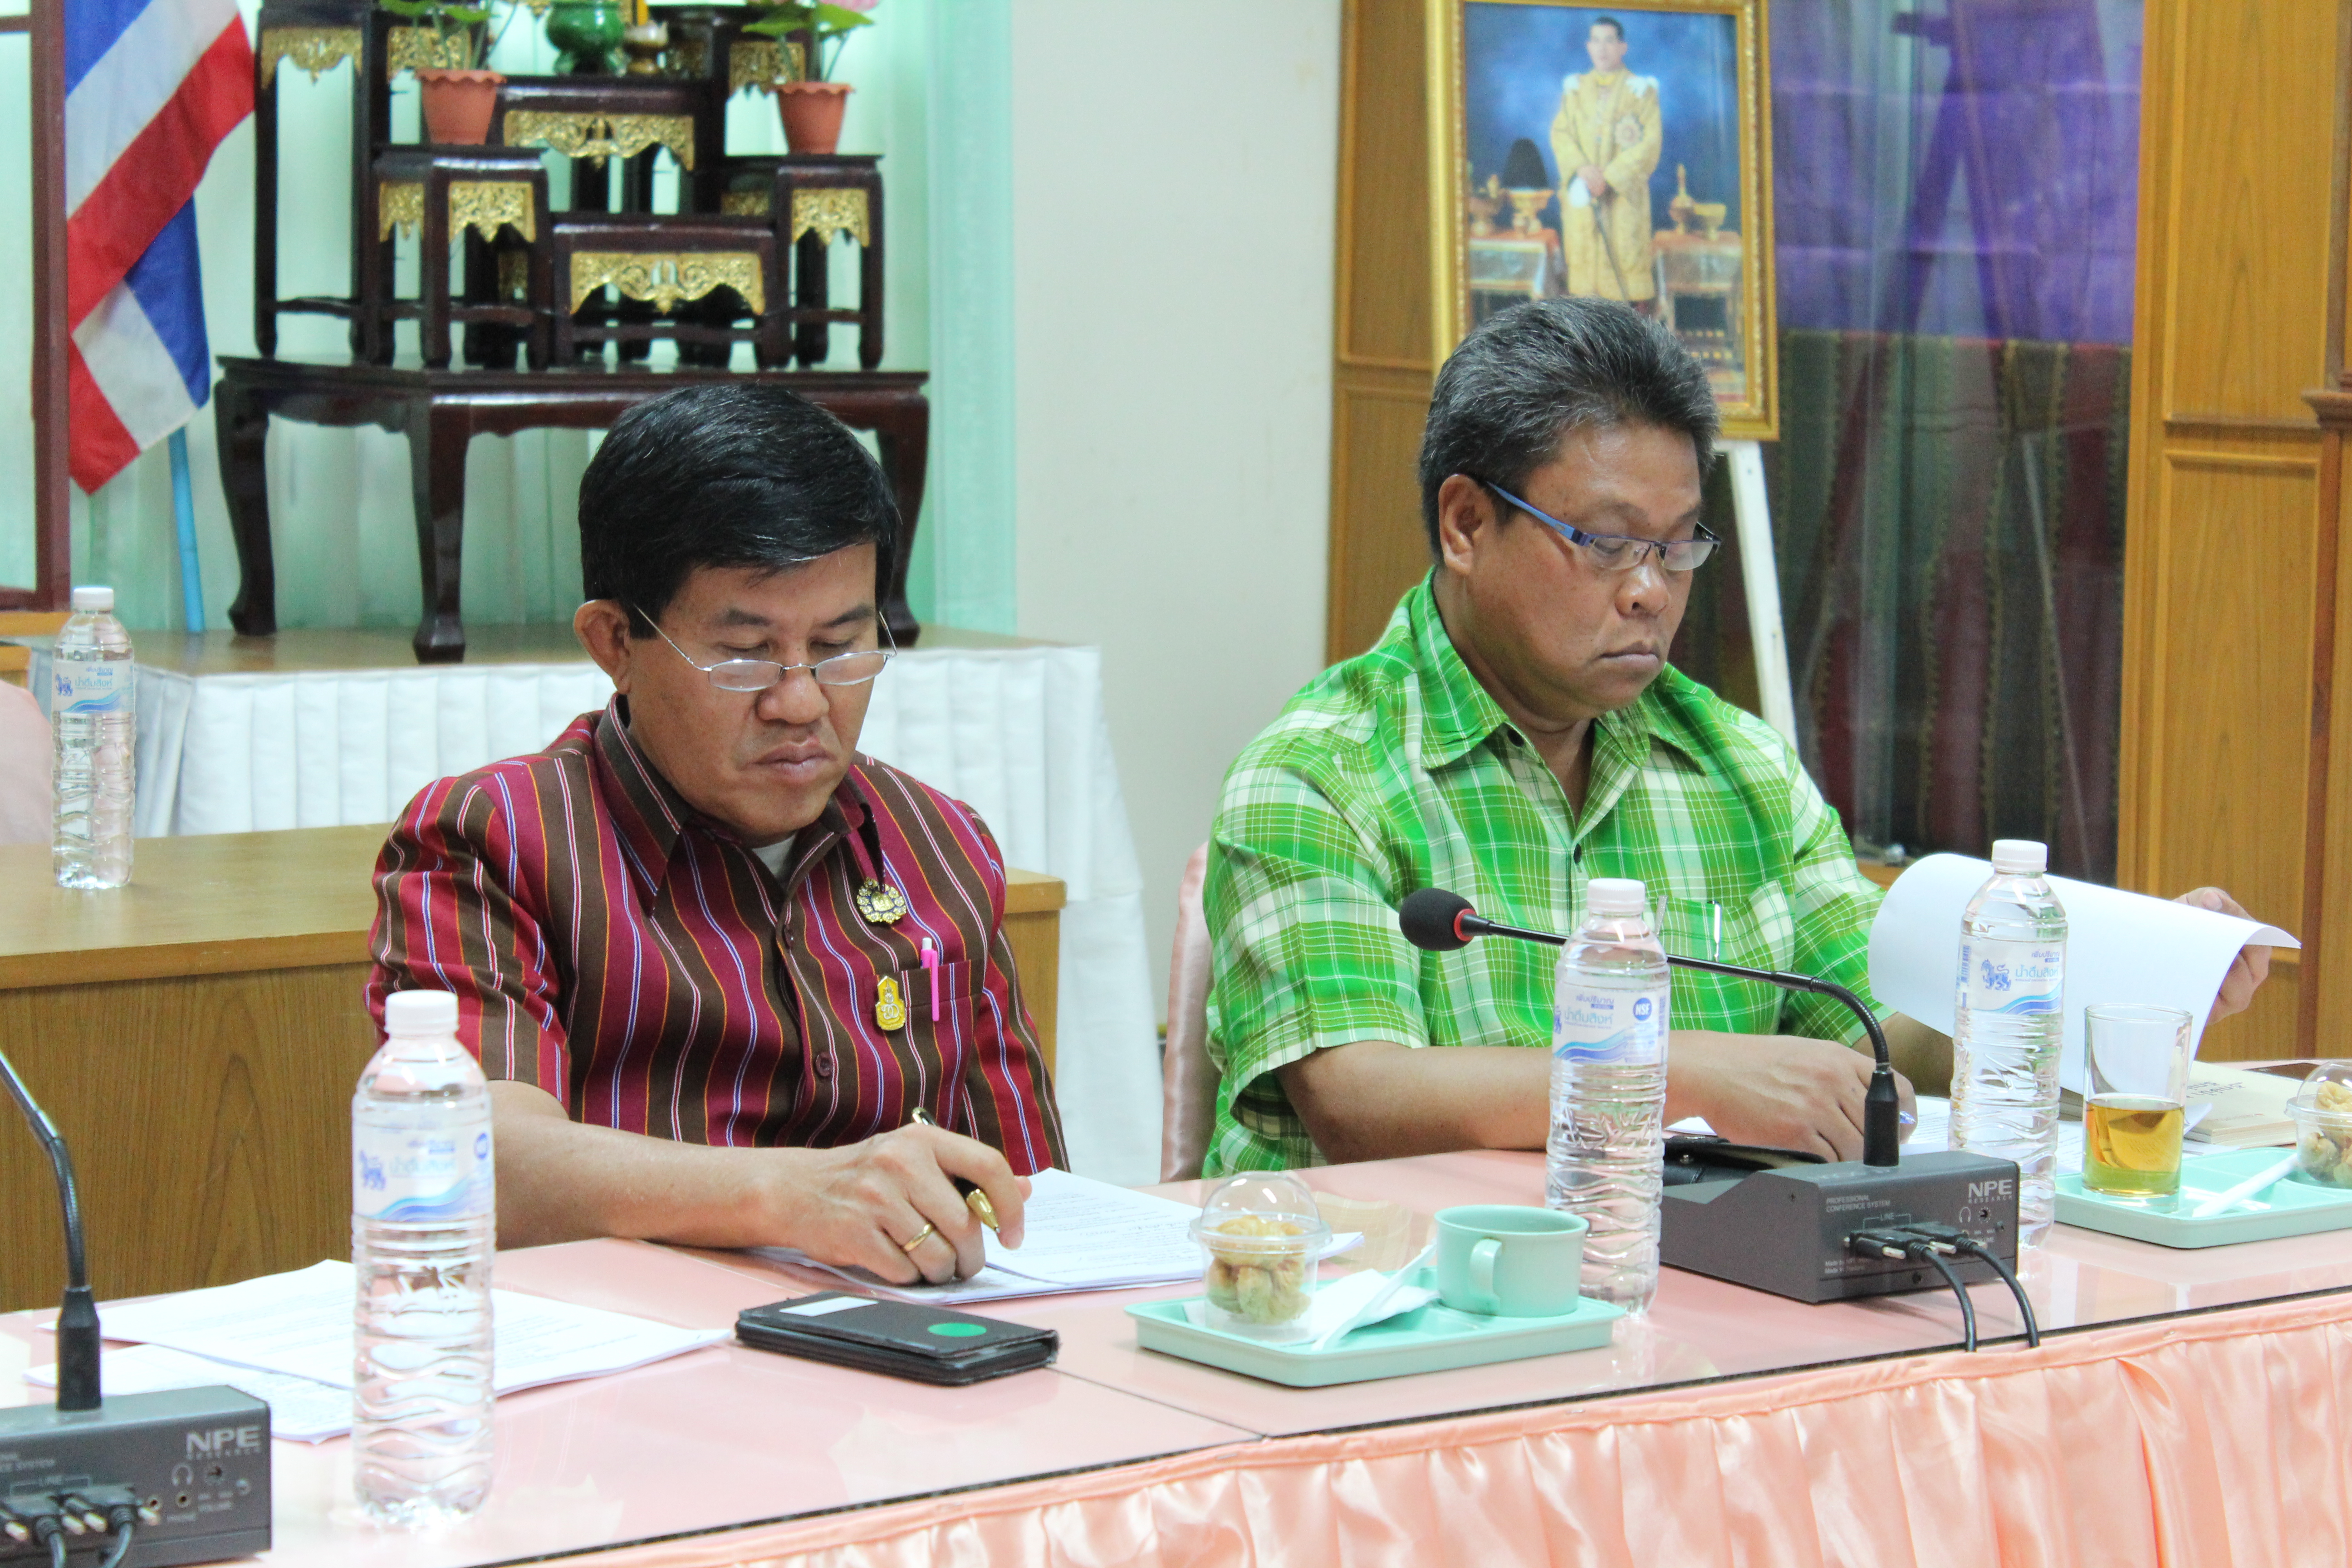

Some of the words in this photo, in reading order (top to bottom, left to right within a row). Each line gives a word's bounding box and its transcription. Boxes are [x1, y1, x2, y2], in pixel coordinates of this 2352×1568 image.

[2015, 965, 2059, 977] น้ำดื่มสิงห์
[1635, 1003, 1650, 1015] NSF
[1564, 1007, 1613, 1024] น้ำดื่มสิงห์
[1968, 1179, 2013, 1197] NPE
[1826, 1202, 1866, 1212] CONFERENCE
[1867, 1200, 1890, 1208] SYSTEM
[1827, 1195, 1869, 1205] PROFESSIONAL
[1880, 1212, 1895, 1221] LINE
[186, 1426, 261, 1453] NPE
